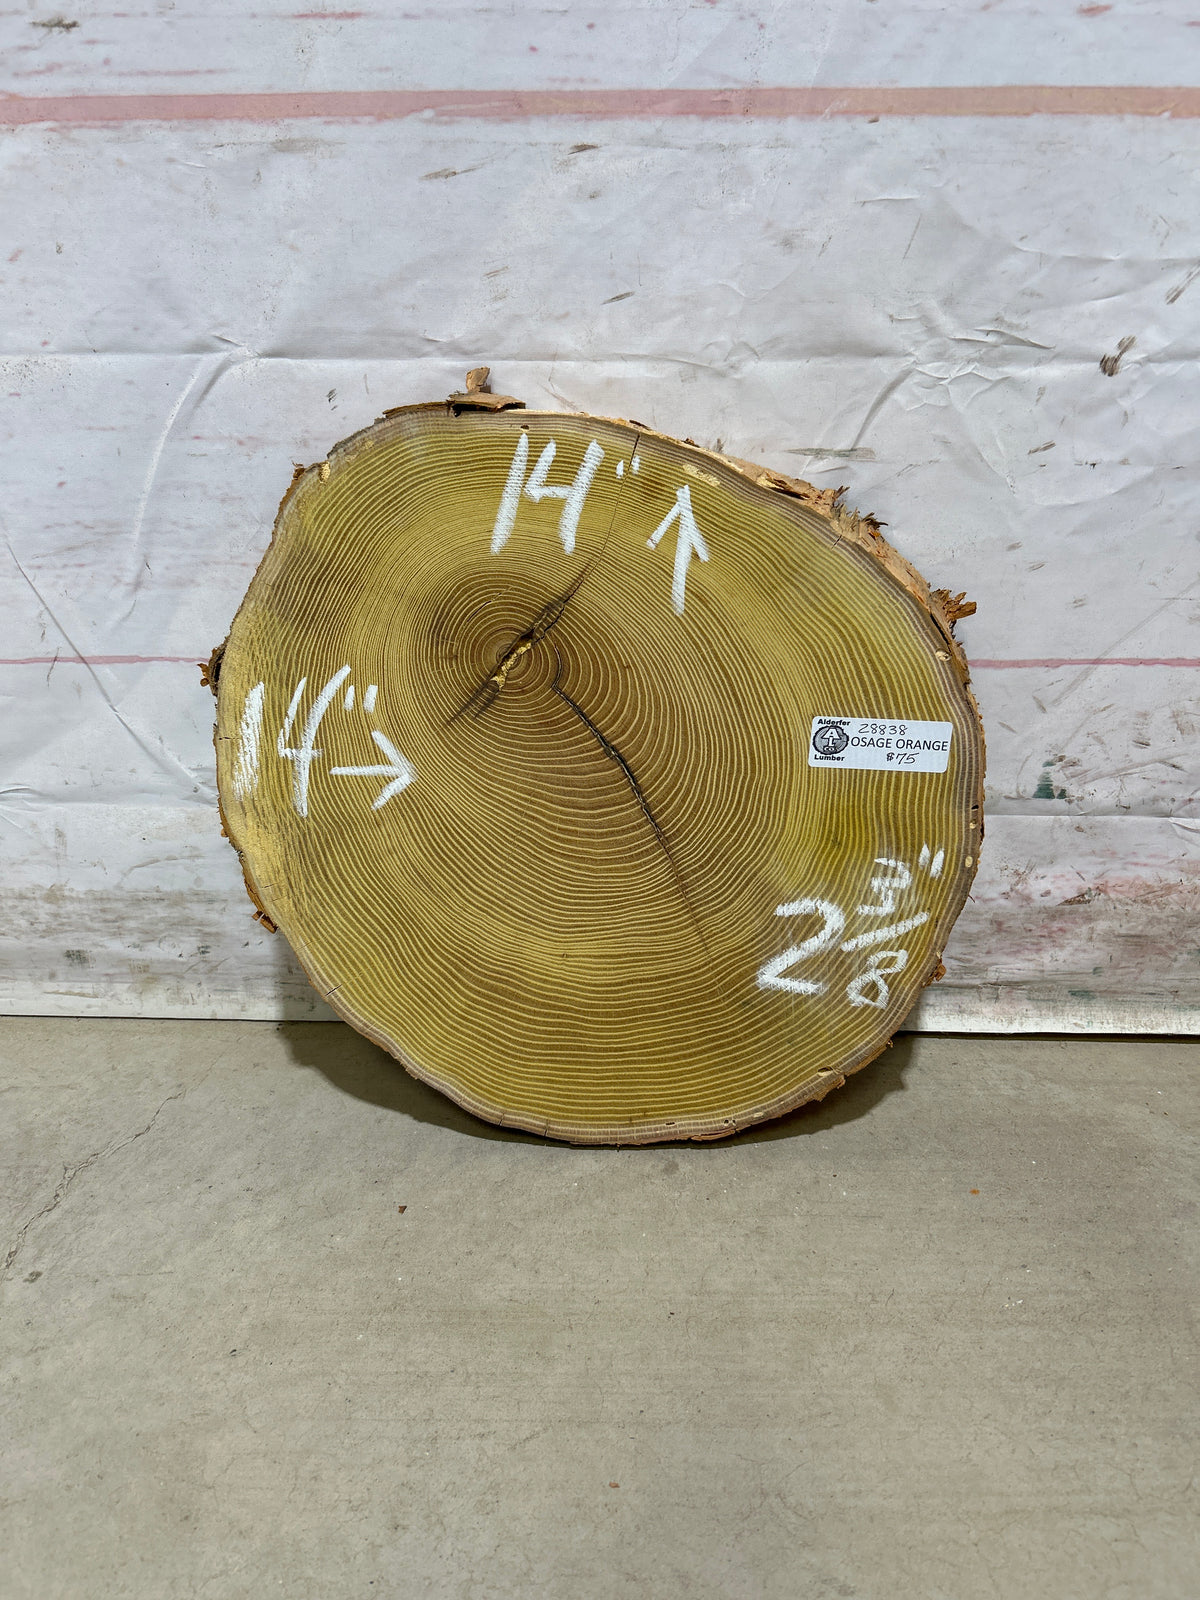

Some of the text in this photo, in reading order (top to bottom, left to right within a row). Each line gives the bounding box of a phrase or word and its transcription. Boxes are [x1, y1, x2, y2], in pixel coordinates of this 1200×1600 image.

[490, 432, 640, 555] 14"
[817, 718, 851, 726] Alderfer
[858, 723, 908, 736] 28838
[232, 664, 378, 818] 14"
[850, 737, 949, 751] OSAGE ORANGE
[886, 752, 920, 765] $75
